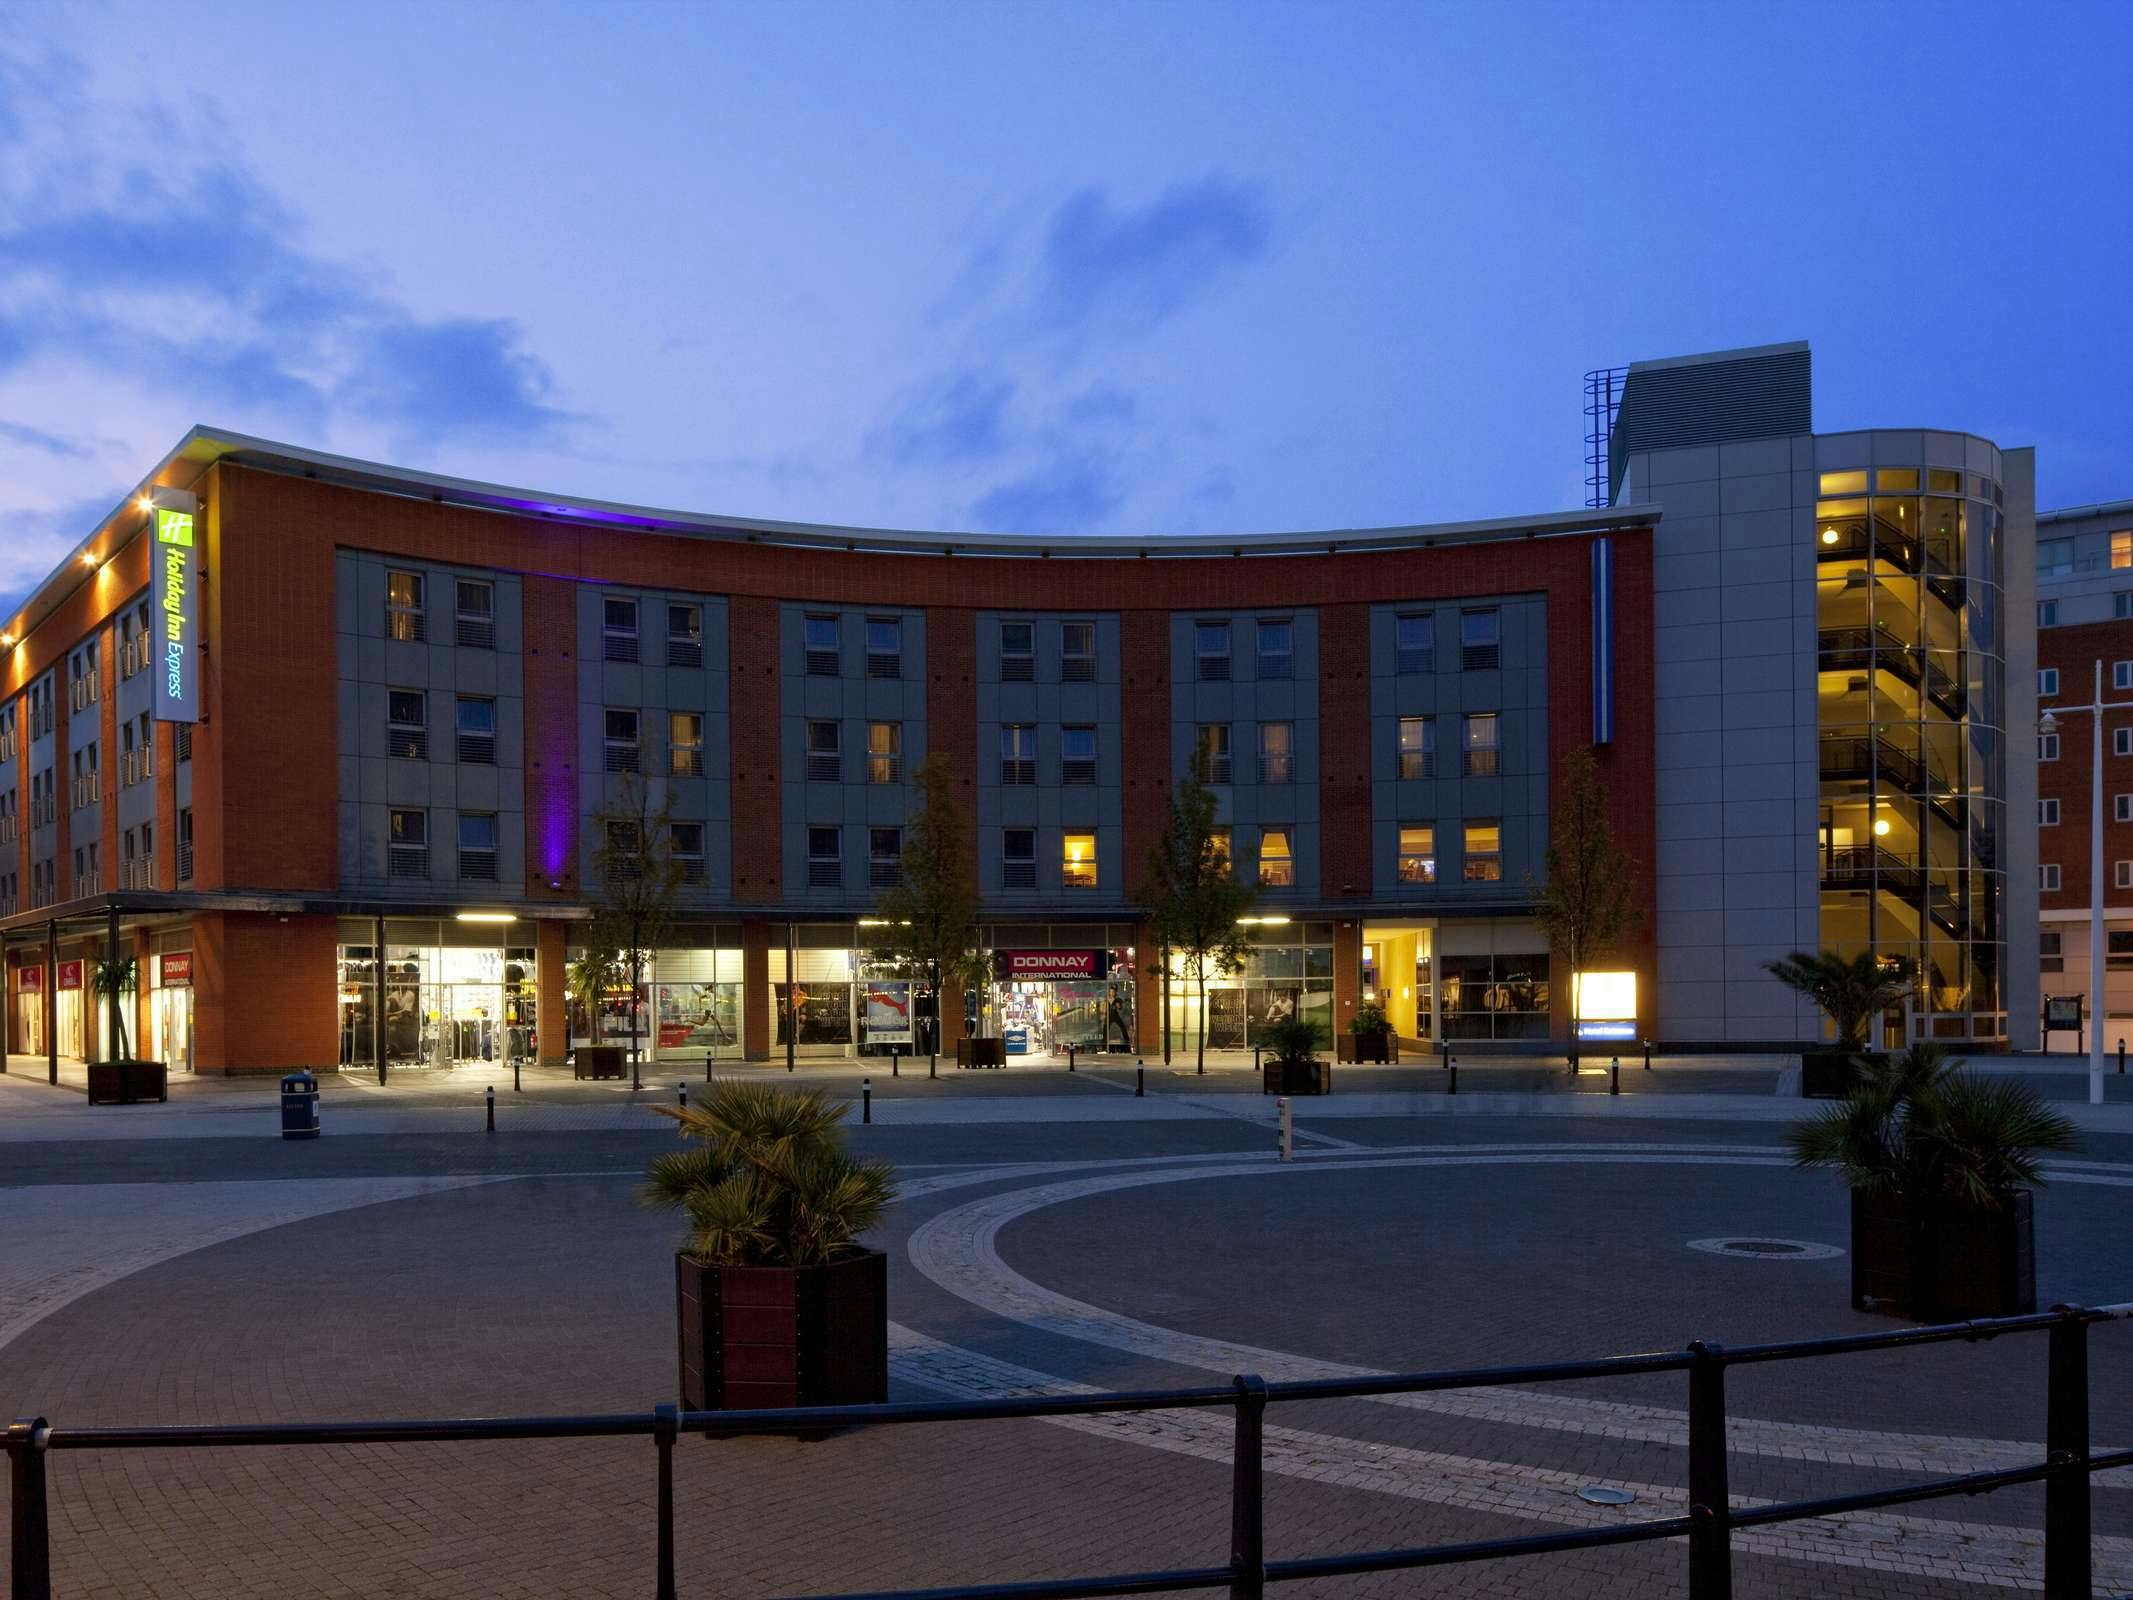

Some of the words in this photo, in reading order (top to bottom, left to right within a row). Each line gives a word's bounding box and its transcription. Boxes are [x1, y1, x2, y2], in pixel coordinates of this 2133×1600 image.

[163, 548, 185, 614] Holiday
[167, 613, 186, 641] Inn
[164, 641, 184, 698] Express
[1013, 956, 1088, 967] DONNAY
